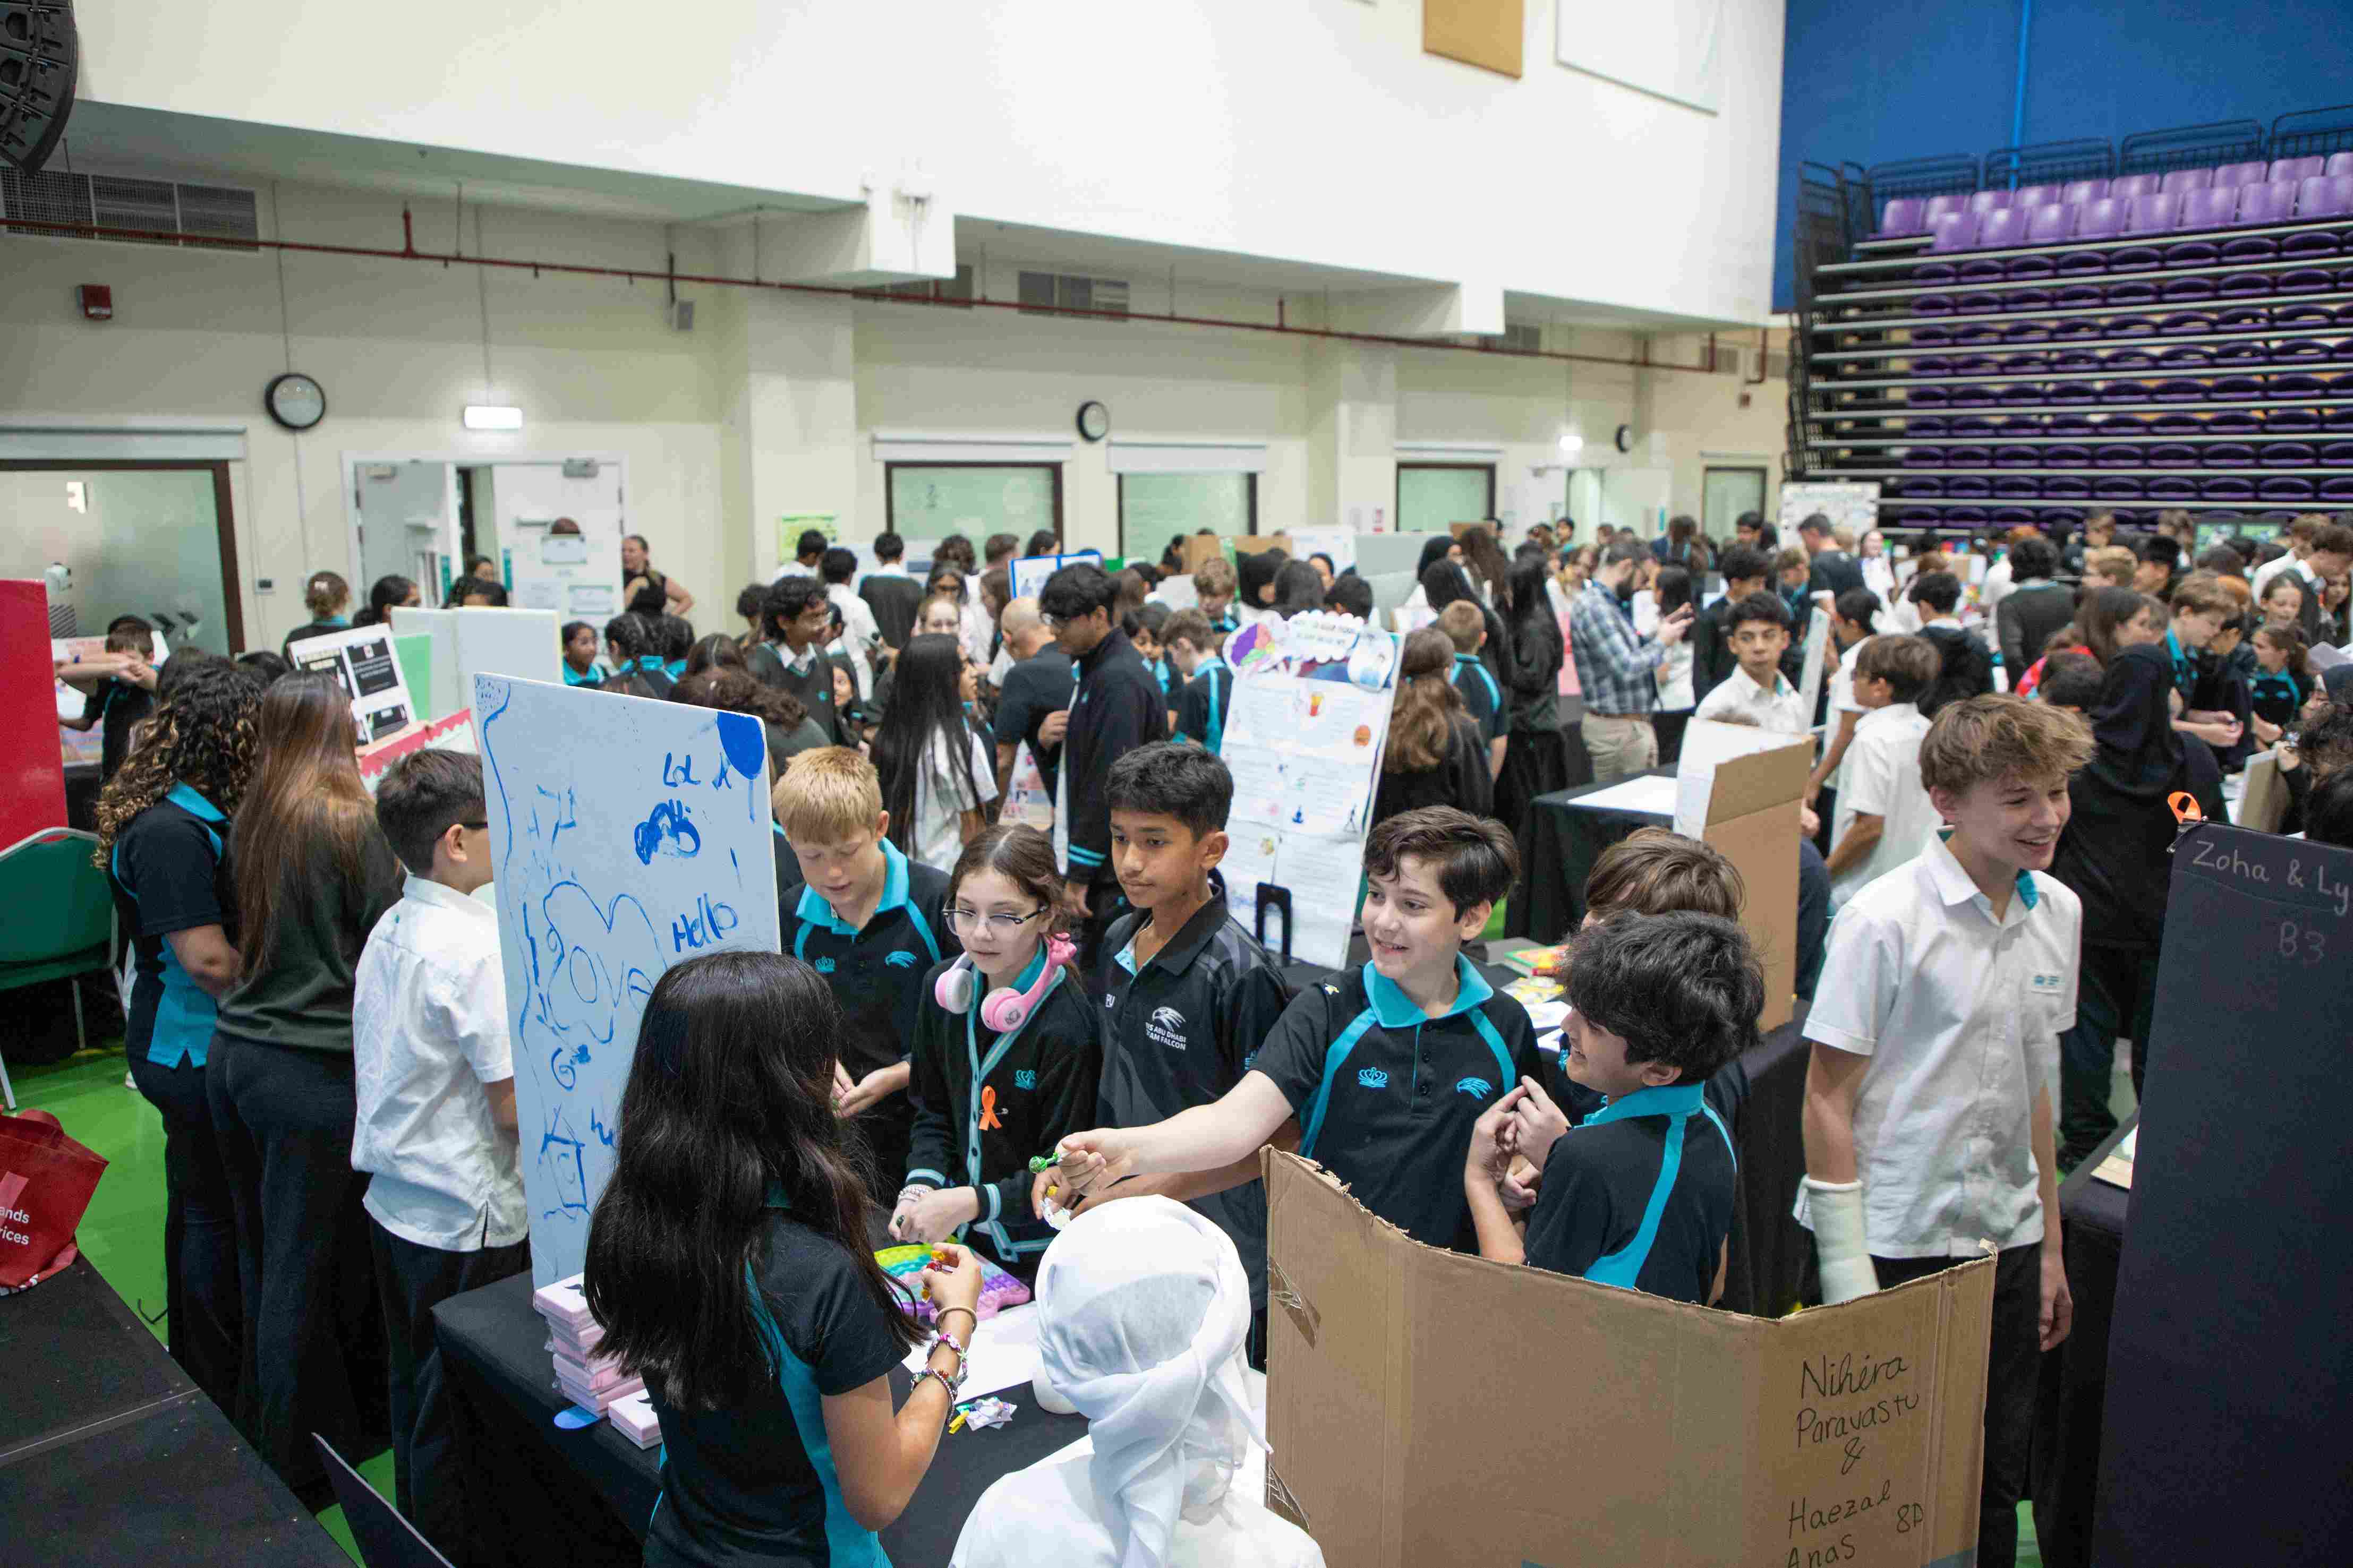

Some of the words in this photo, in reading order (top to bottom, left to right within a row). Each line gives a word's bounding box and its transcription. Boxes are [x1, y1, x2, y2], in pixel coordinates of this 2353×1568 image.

[2193, 840, 2270, 882] Zoha
[2287, 859, 2304, 888] &
[671, 893, 739, 953] Hello
[1154, 1026, 1166, 1036] ABU
[1166, 1031, 1187, 1043] DHABI
[1161, 1036, 1186, 1051] FALCON
[1796, 1393, 1920, 1449] Paravastu
[1841, 1437, 1866, 1475] &
